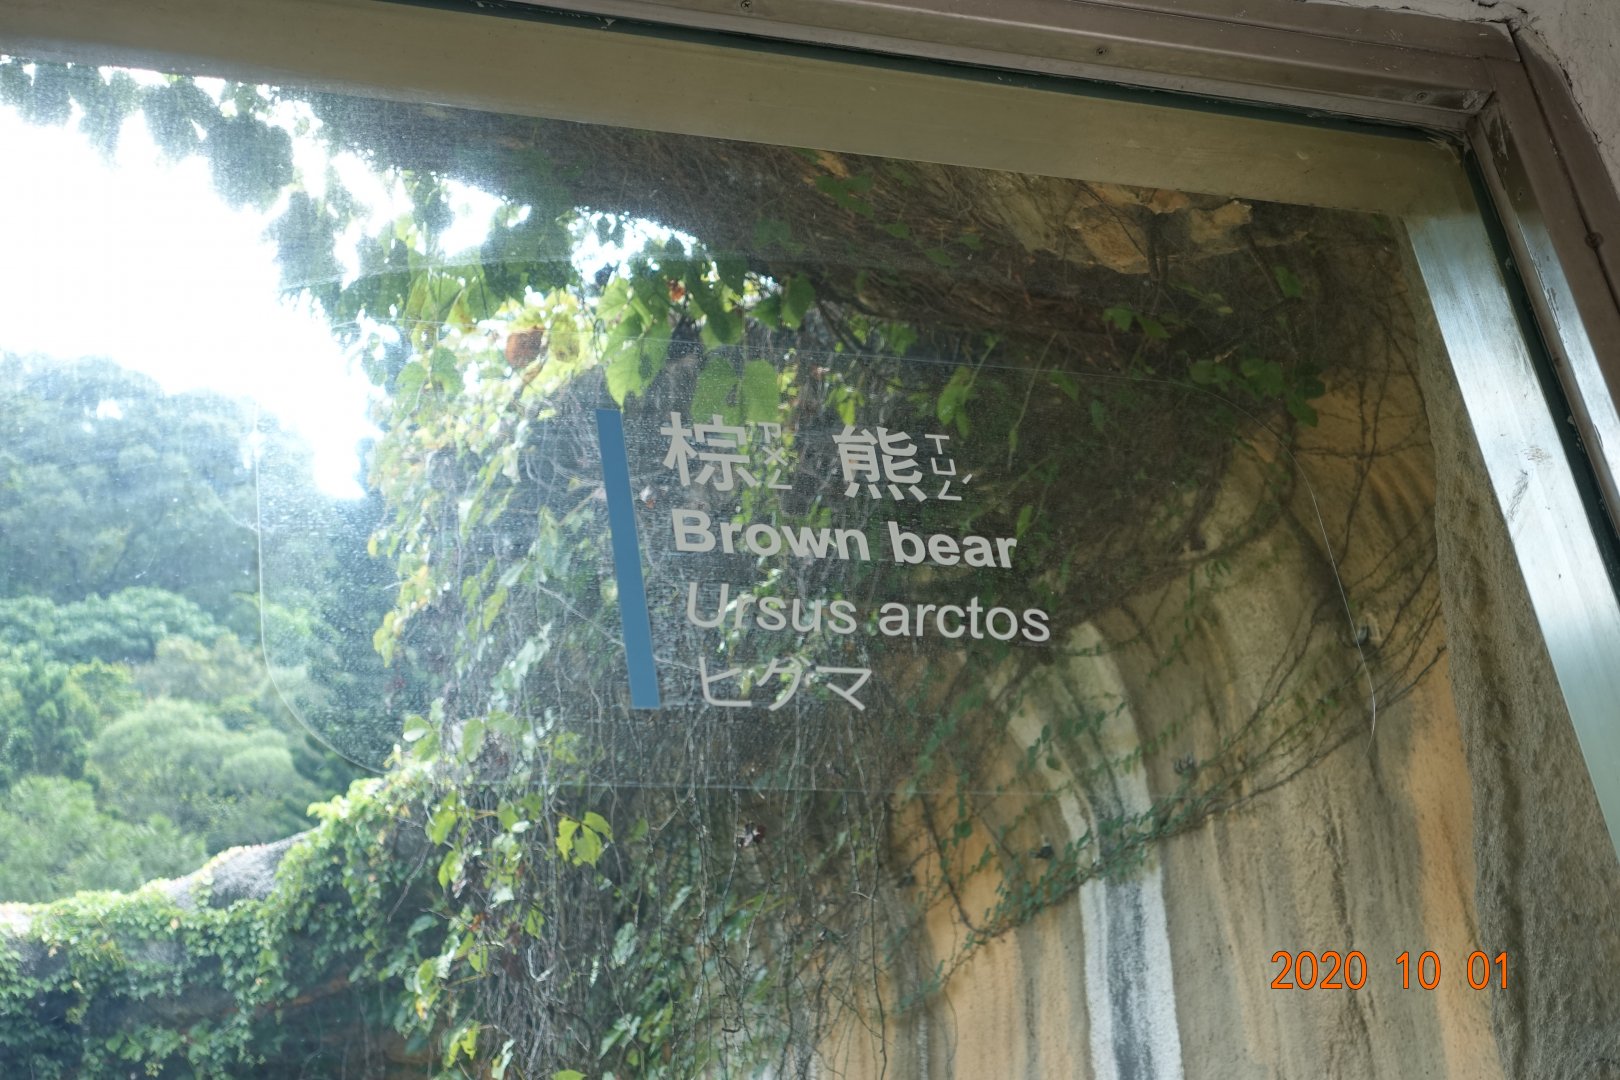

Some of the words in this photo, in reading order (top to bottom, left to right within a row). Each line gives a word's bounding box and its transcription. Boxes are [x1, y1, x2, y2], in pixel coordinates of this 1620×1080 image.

[660, 411, 757, 491] 棕
[832, 424, 928, 502] 熊
[671, 508, 871, 562] Brown
[888, 521, 1018, 569] bear
[686, 582, 858, 635] Ursus
[879, 596, 1051, 643] arctos
[698, 656, 872, 711] ヒグマ
